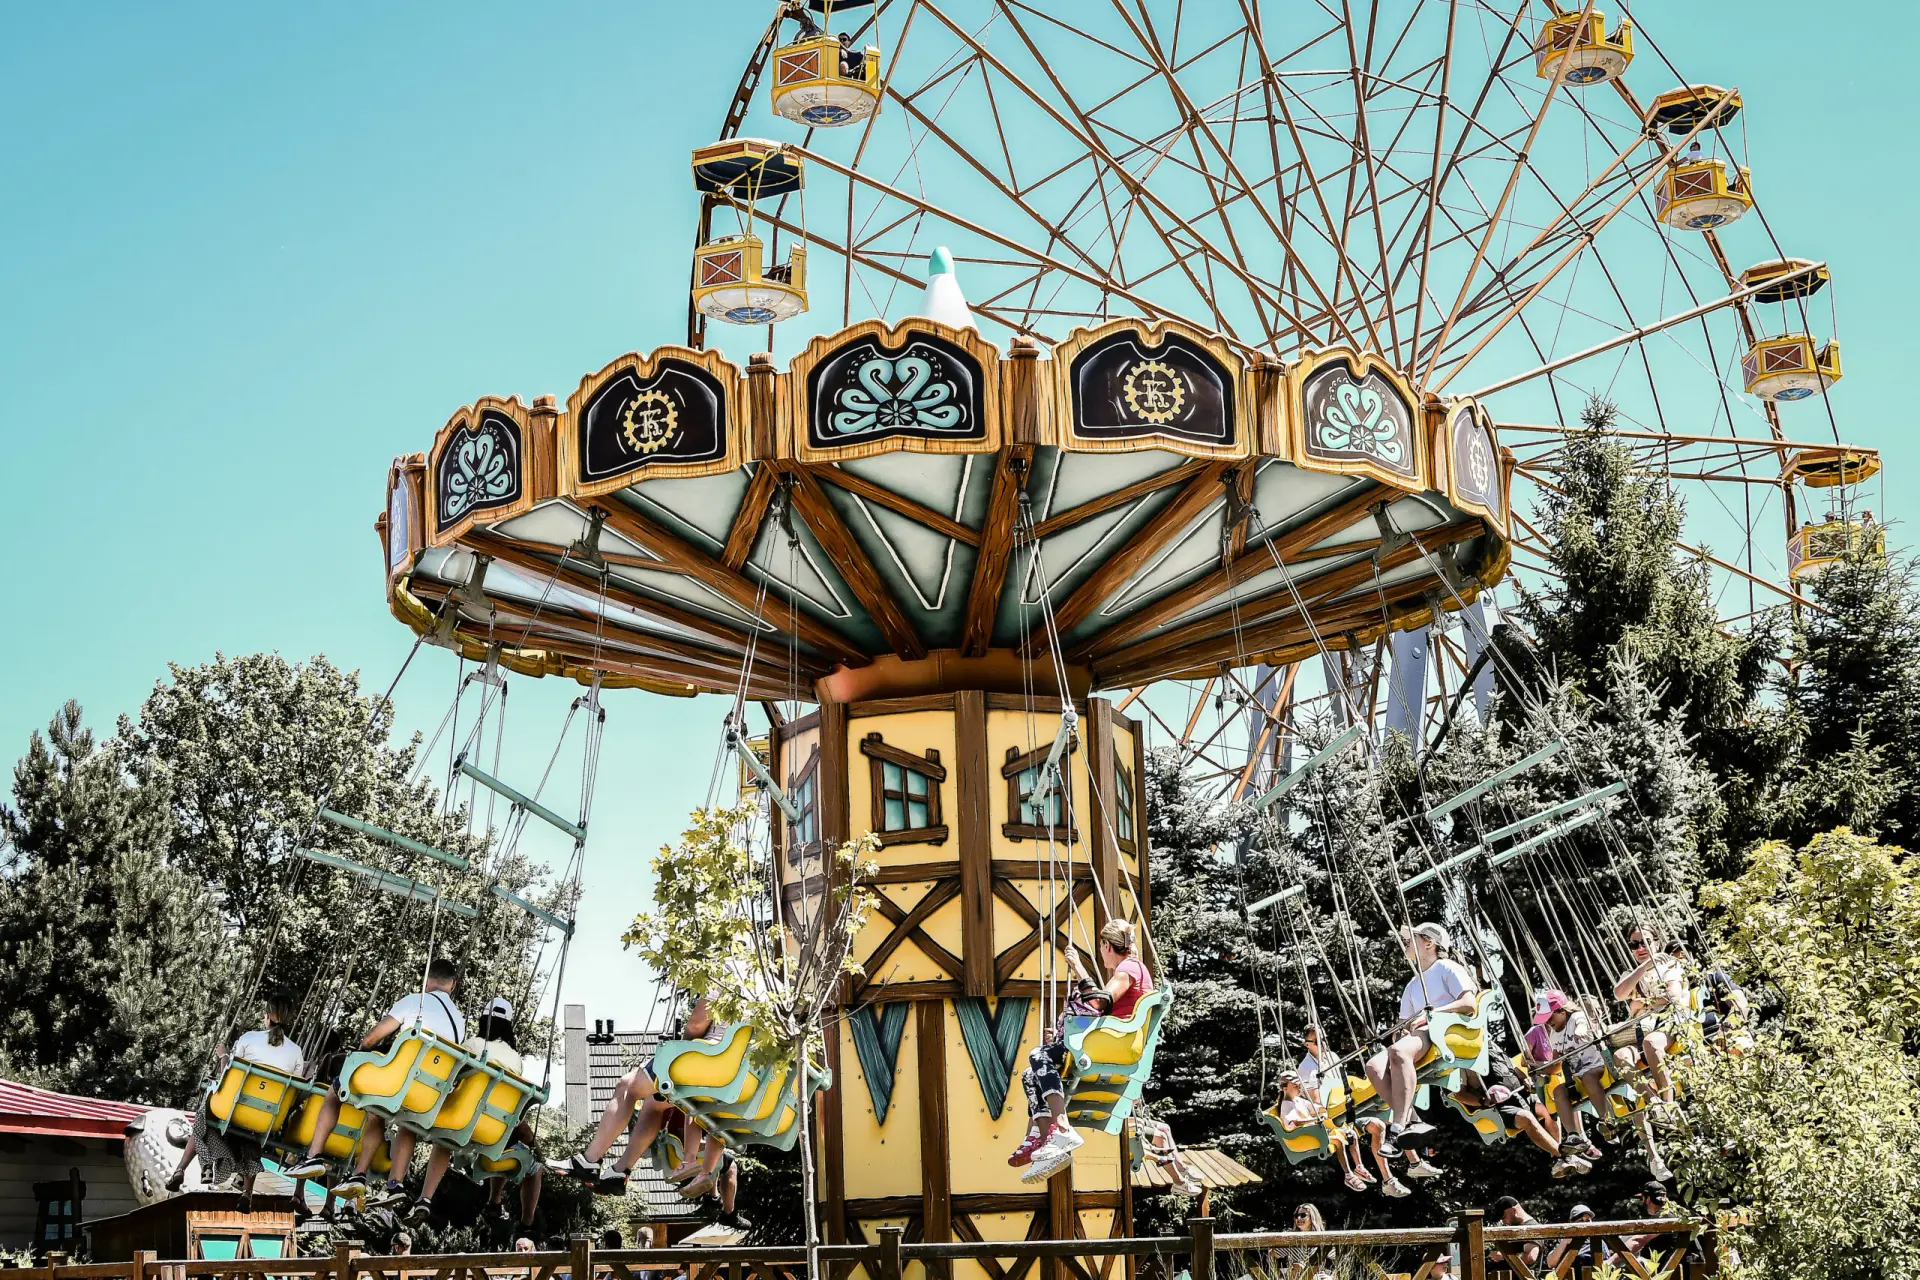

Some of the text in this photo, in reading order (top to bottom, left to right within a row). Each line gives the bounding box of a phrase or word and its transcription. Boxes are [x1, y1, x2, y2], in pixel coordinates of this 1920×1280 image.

[1142, 379, 1170, 408] K
[639, 408, 663, 438] K
[433, 1055, 440, 1064] 6
[259, 1081, 266, 1090] 5
